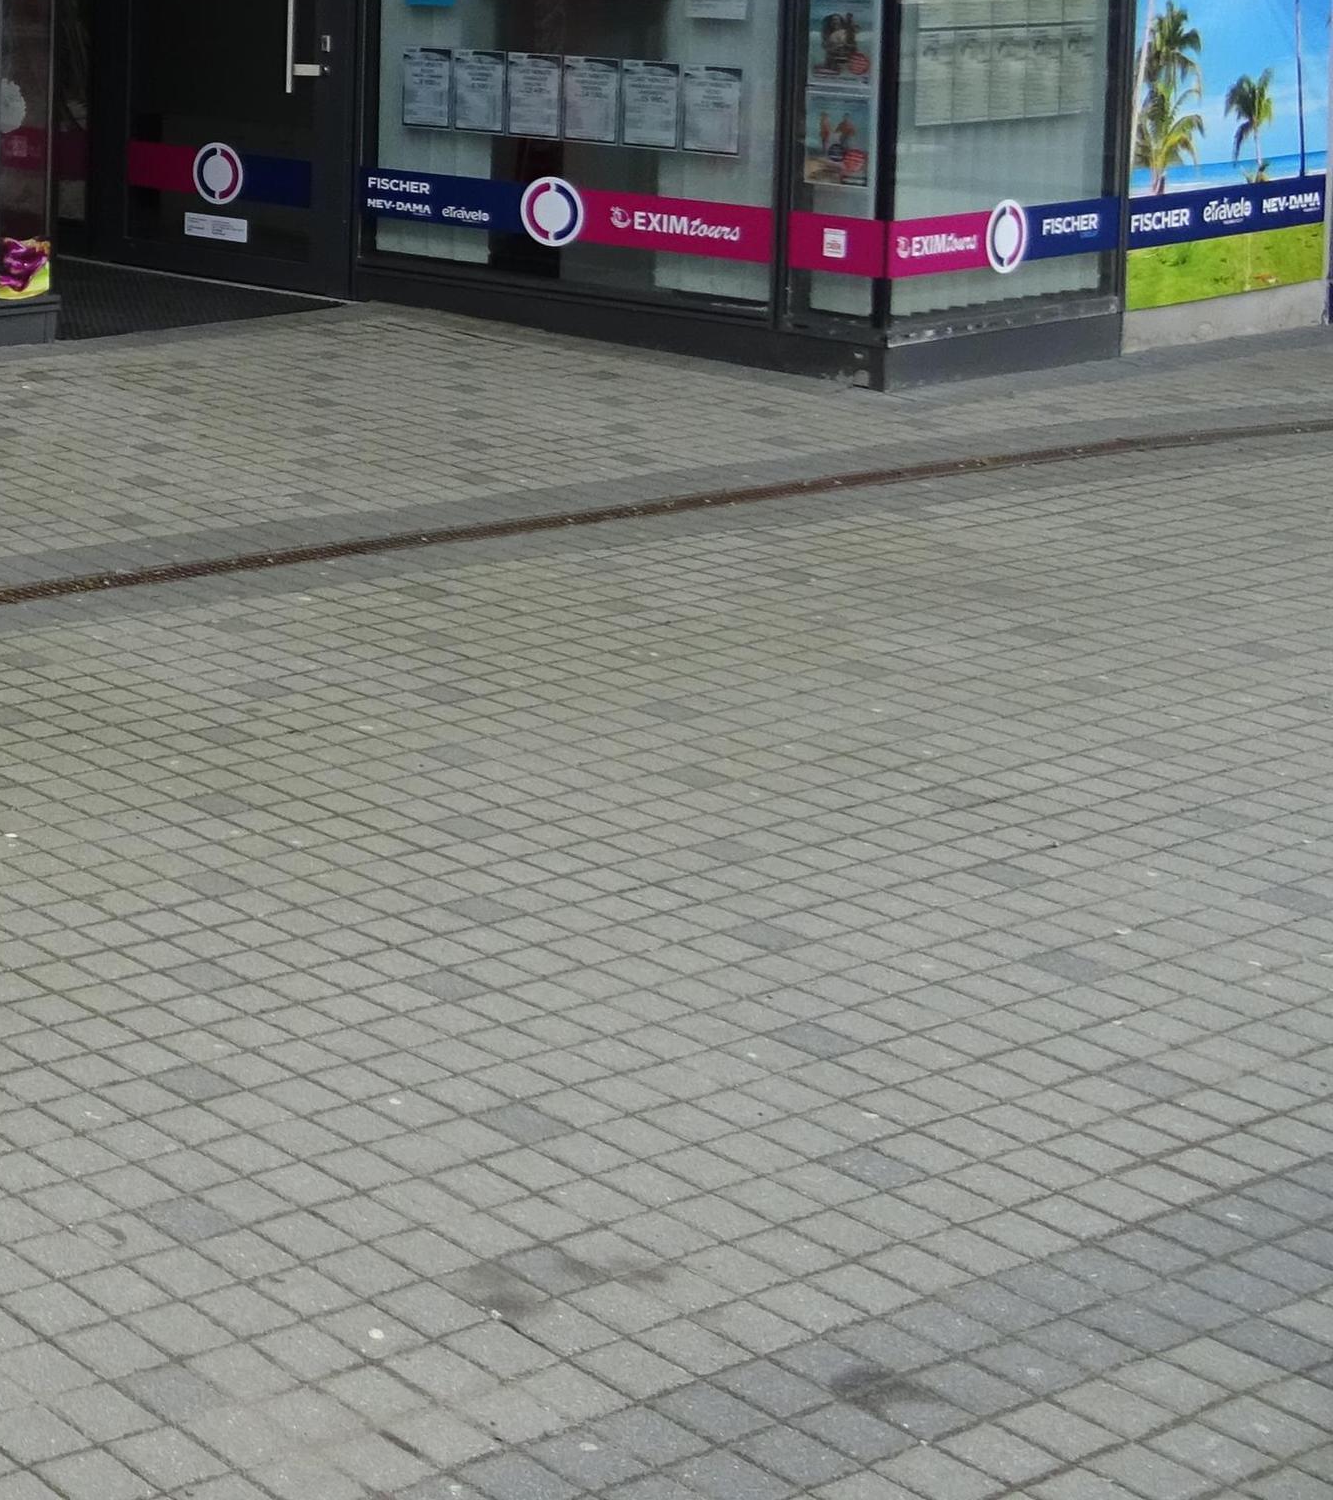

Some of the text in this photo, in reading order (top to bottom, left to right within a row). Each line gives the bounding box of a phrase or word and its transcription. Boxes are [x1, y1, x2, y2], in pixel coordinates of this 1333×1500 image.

[367, 176, 430, 195] FISCHER
[366, 198, 432, 215] NEV-DAMA
[1130, 208, 1190, 233] FISCHER
[1262, 192, 1321, 213] NEV-DAMA
[1042, 213, 1098, 236] FISCHER
